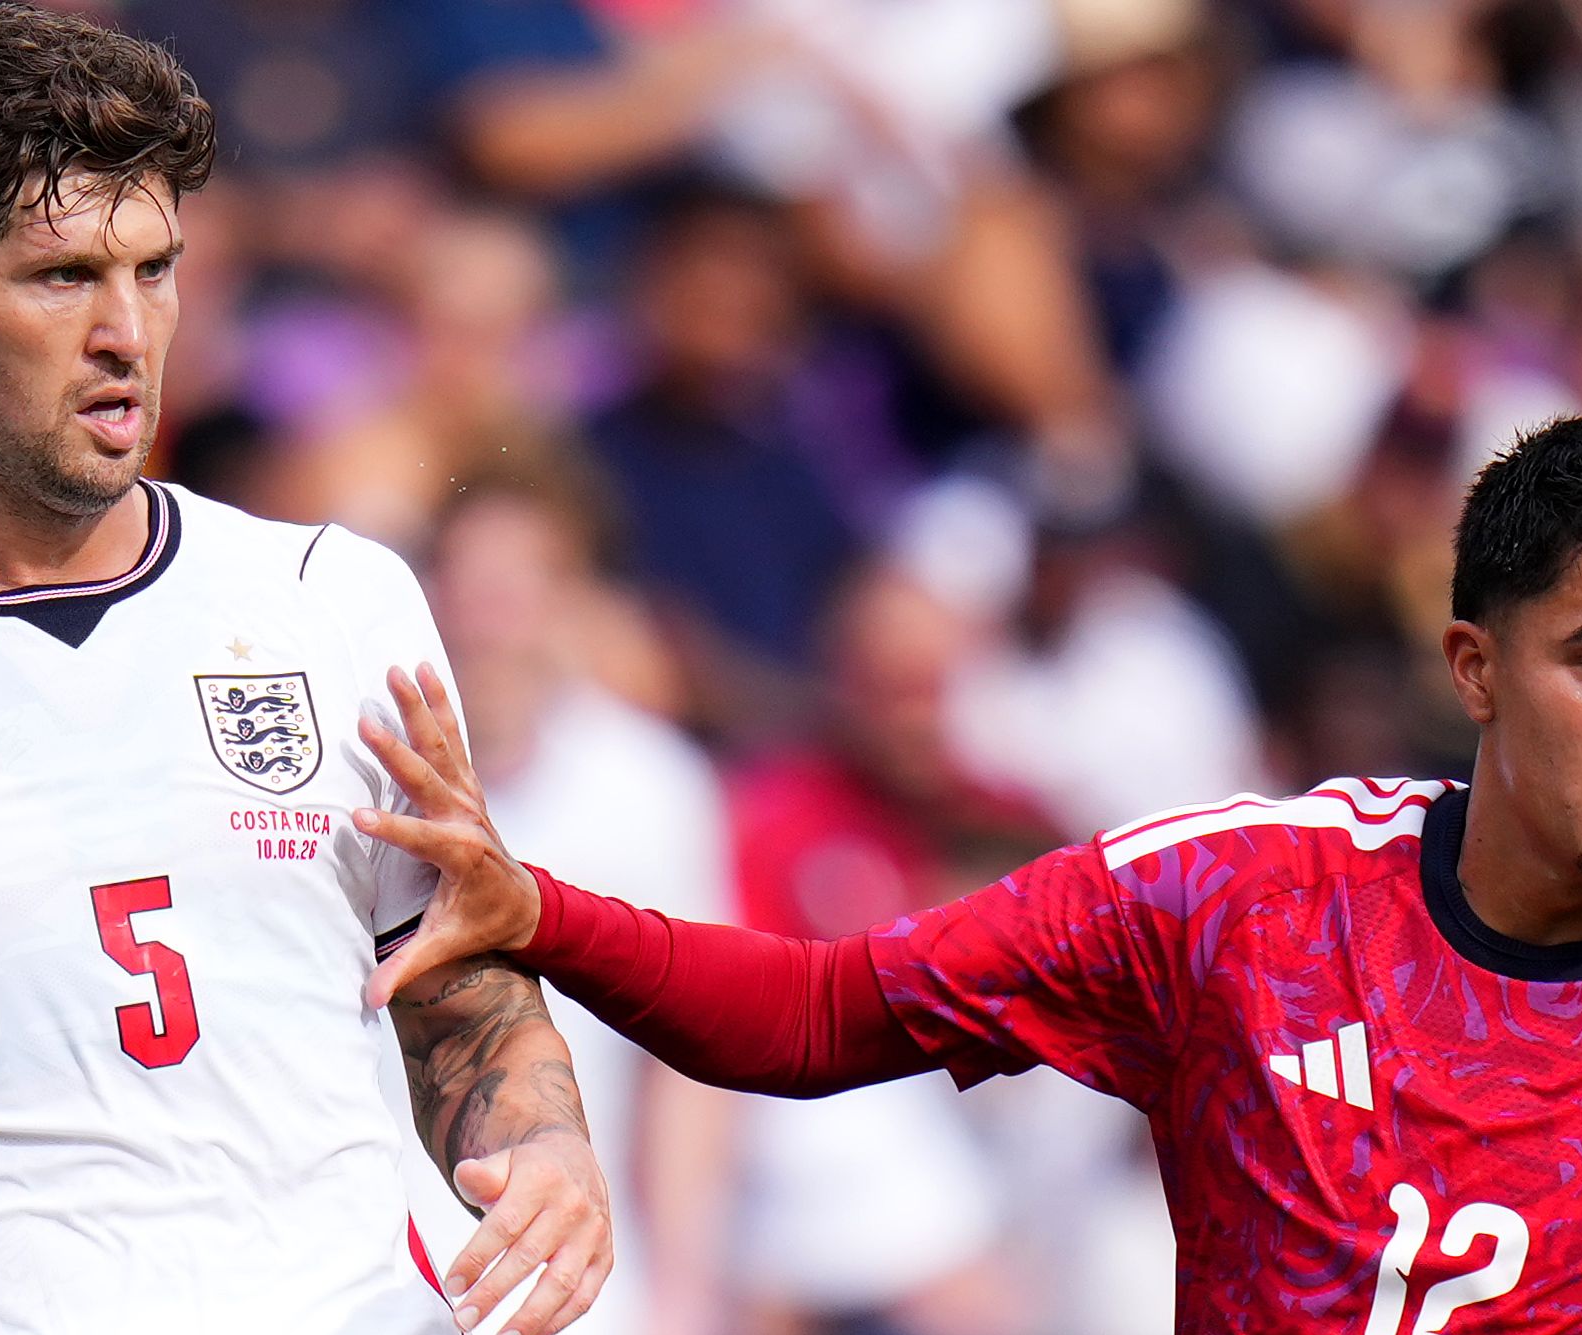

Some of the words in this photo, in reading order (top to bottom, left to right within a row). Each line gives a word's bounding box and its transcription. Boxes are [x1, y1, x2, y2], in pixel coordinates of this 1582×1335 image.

[230, 810, 292, 831] COSTA
[294, 811, 331, 836] RICA
[256, 838, 318, 861] 10.06.26
[89, 874, 201, 1070] 5
